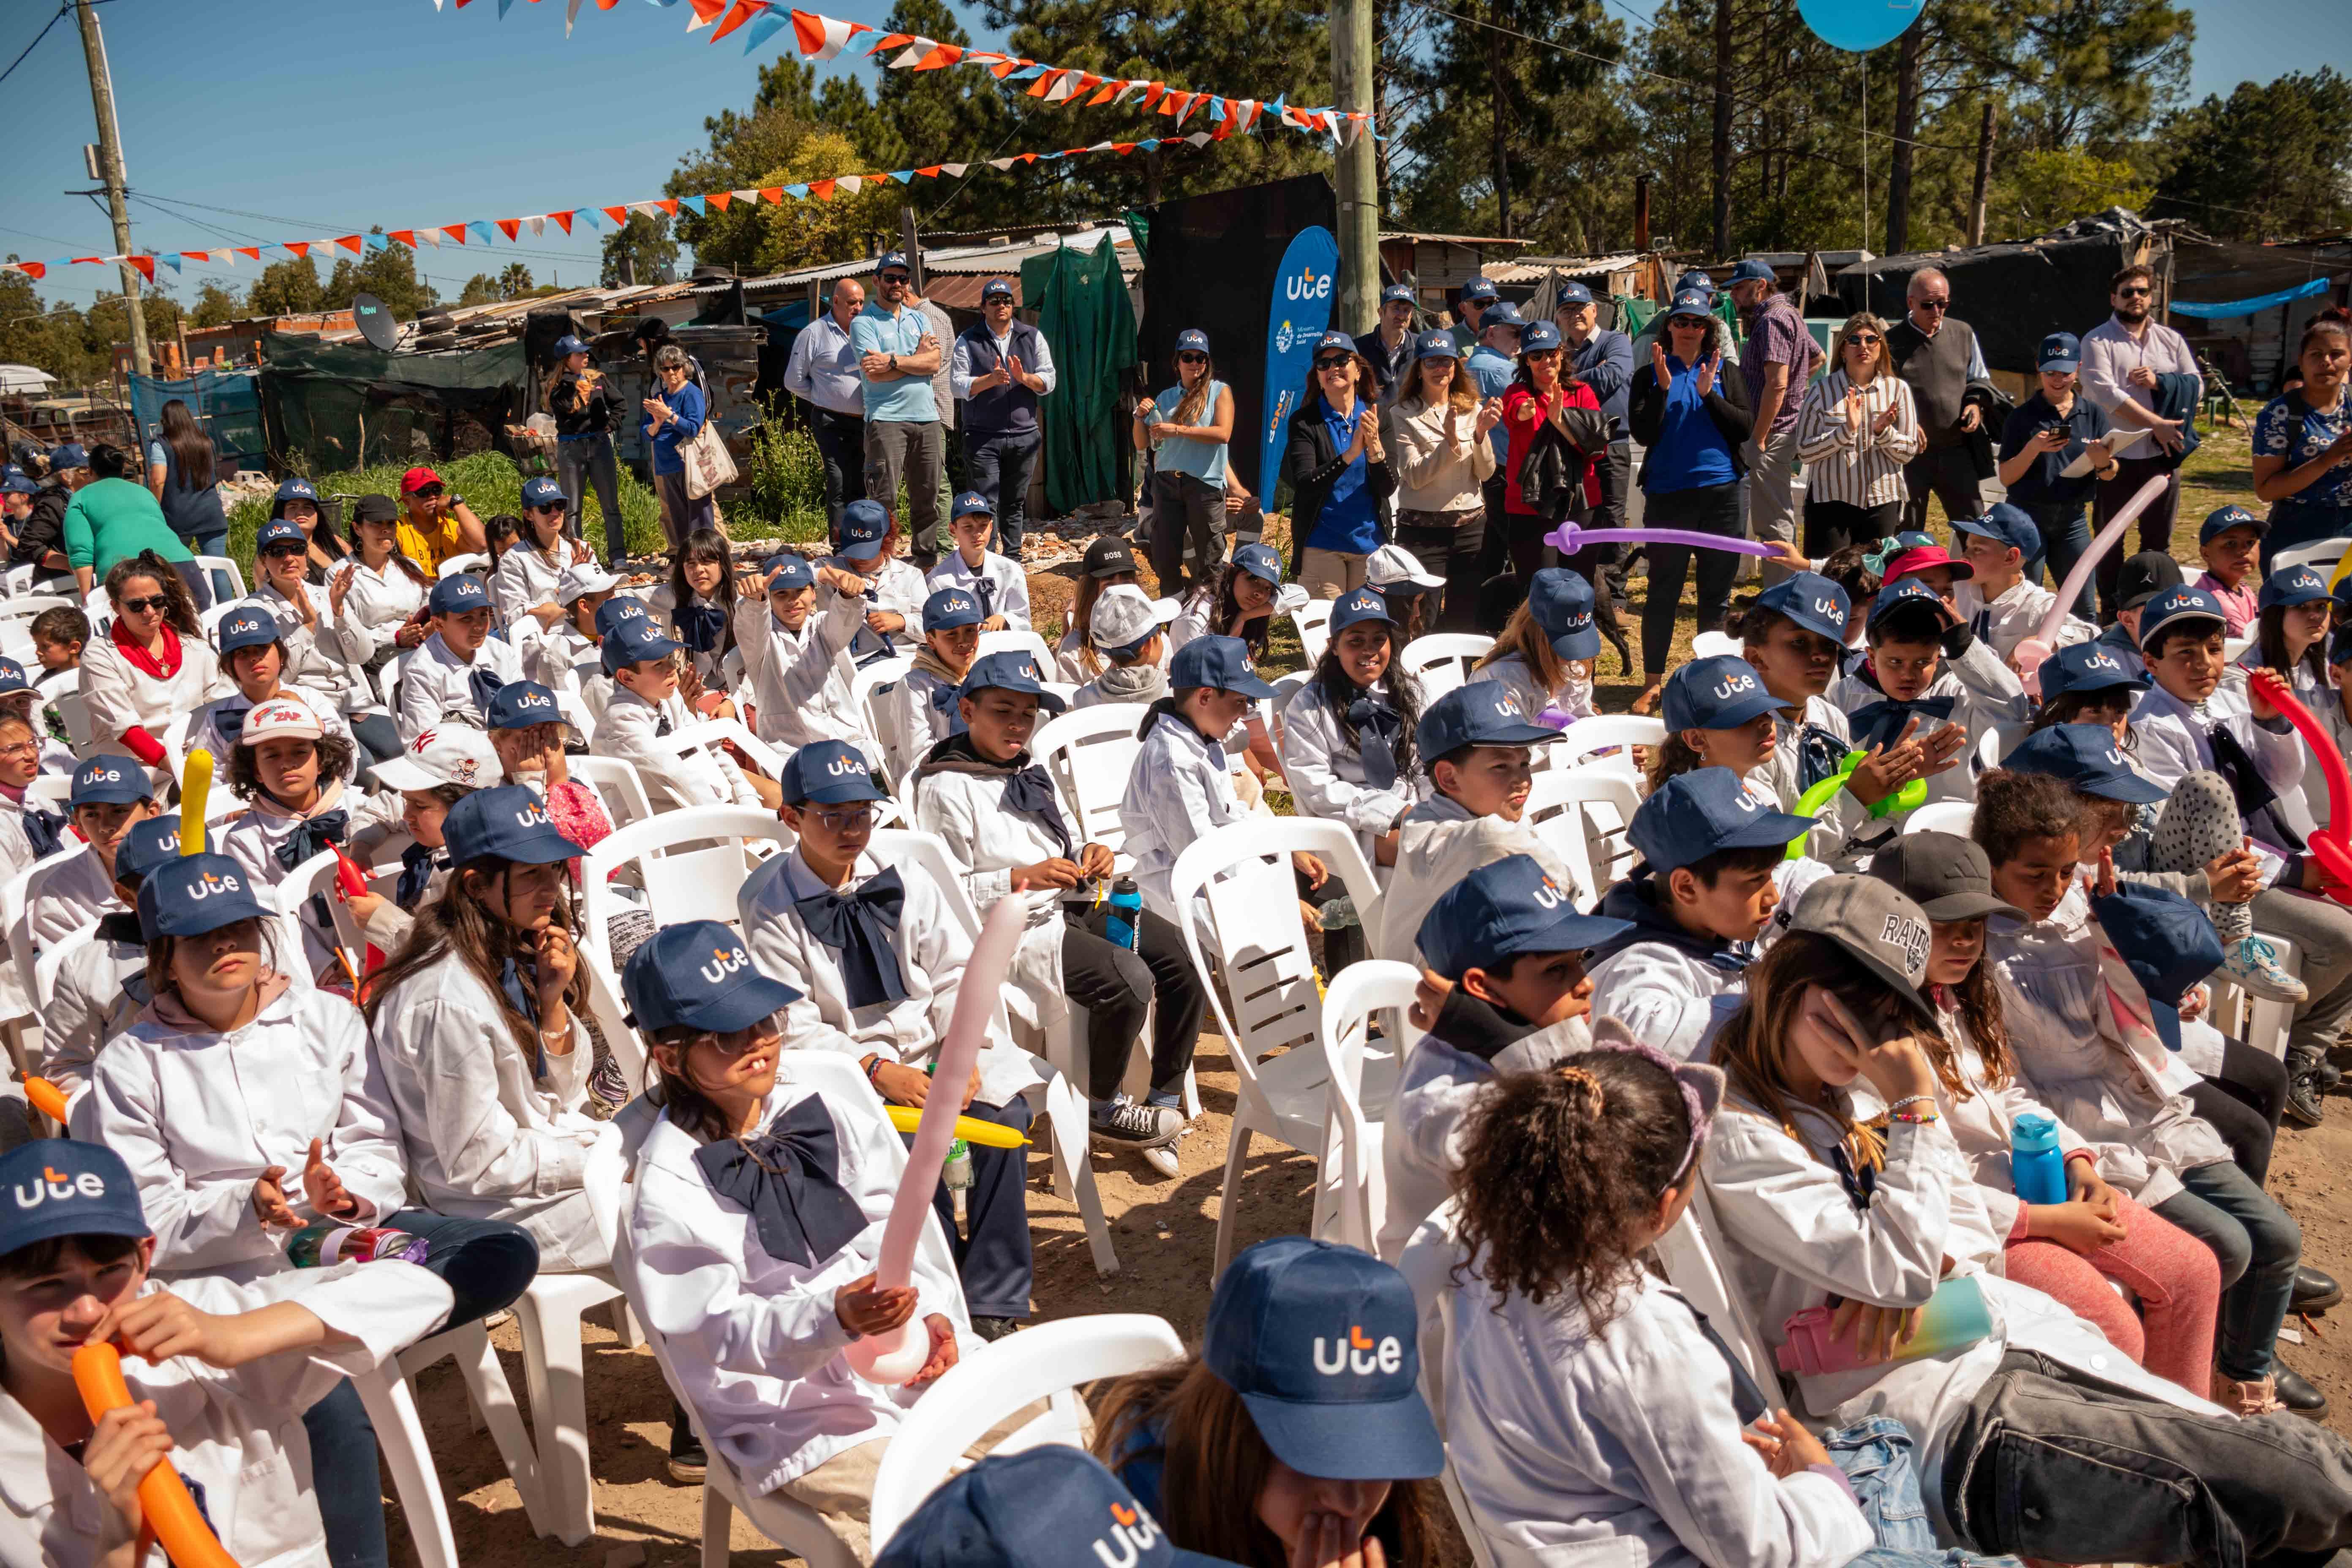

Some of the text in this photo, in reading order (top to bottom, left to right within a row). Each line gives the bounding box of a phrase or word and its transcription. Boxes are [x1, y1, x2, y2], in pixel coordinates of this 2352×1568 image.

[889, 255, 904, 264] ute
[1287, 267, 1331, 301] ute
[1476, 282, 1491, 290] ute
[1696, 277, 1710, 286] ute
[1394, 288, 1410, 297] ute
[1563, 289, 1579, 298] ute
[1679, 294, 1699, 305] ute
[1511, 309, 1521, 318] ut
[1187, 334, 1203, 344] ute
[1320, 335, 1341, 346] ute
[1428, 337, 1448, 347] ute
[1528, 329, 1548, 340] ute
[2048, 345, 2069, 357] ute
[292, 482, 311, 495] ute
[538, 483, 557, 494] ute
[965, 496, 984, 507] ute
[2224, 511, 2250, 522] ute
[268, 525, 291, 537] ute
[851, 527, 872, 539] ute
[1104, 551, 1122, 560] BOSS
[780, 564, 797, 574] te
[1261, 557, 1280, 575] ute
[2292, 574, 2322, 588] ute
[457, 583, 482, 596] ute
[944, 598, 970, 613] ute
[1351, 596, 1382, 611] ute
[2164, 593, 2204, 610] ute
[619, 605, 644, 620] ute
[1814, 596, 1844, 626] ute
[230, 619, 259, 635] ute
[1567, 611, 1591, 628] ute
[1241, 653, 1254, 672] ut
[2085, 652, 2120, 670] ute
[1019, 664, 1038, 681] ut
[1713, 674, 1756, 700] ute
[517, 691, 551, 708] ute
[274, 711, 301, 722] ZAP
[828, 755, 867, 776] ute
[83, 767, 121, 785] ute
[1734, 784, 1763, 812] ut
[158, 830, 181, 851] ut
[187, 872, 240, 900] ute
[1533, 875, 1566, 909] ut
[1879, 913, 1930, 954] RAID
[701, 947, 750, 984] ute
[14, 1166, 105, 1210] ute
[1313, 1325, 1402, 1376] ute
